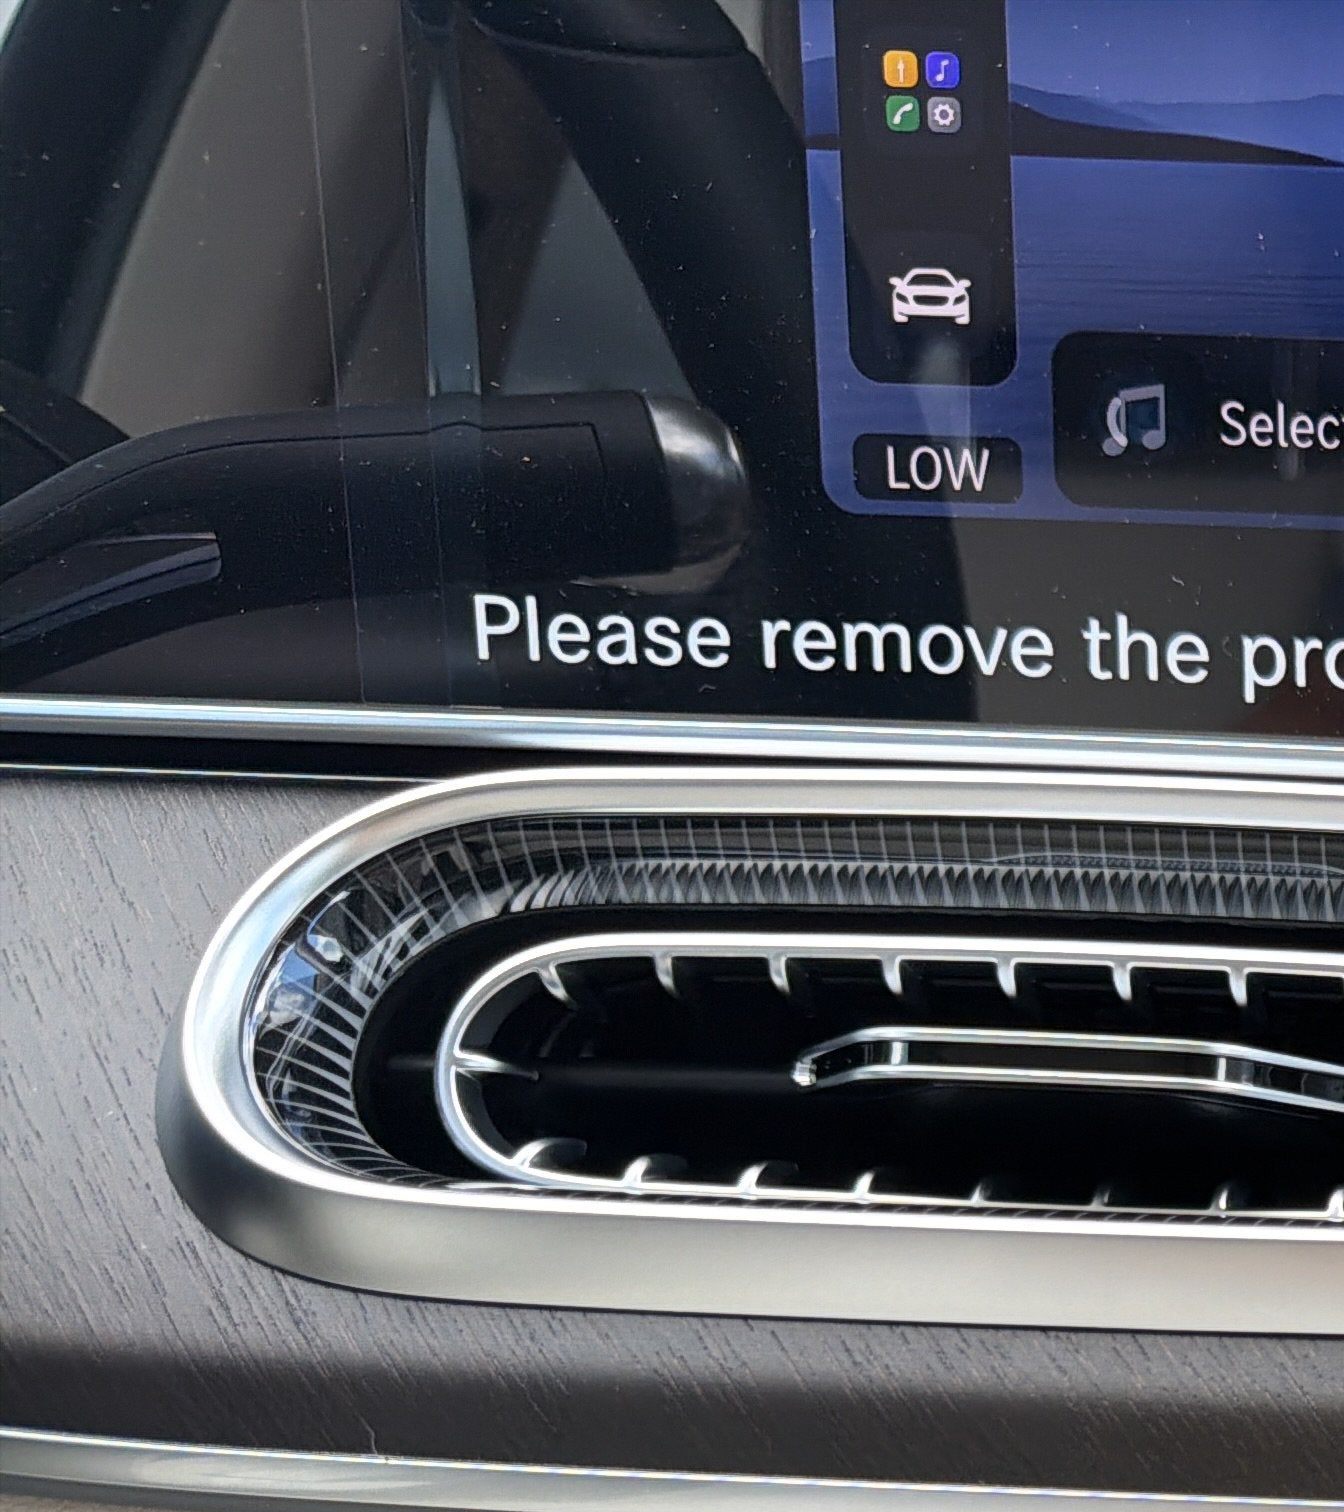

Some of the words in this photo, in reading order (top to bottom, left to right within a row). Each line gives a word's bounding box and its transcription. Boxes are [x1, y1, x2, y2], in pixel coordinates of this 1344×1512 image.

[886, 445, 990, 492] LOW
[473, 593, 731, 668] Please
[761, 619, 1054, 678] remove
[1082, 613, 1210, 684] the
